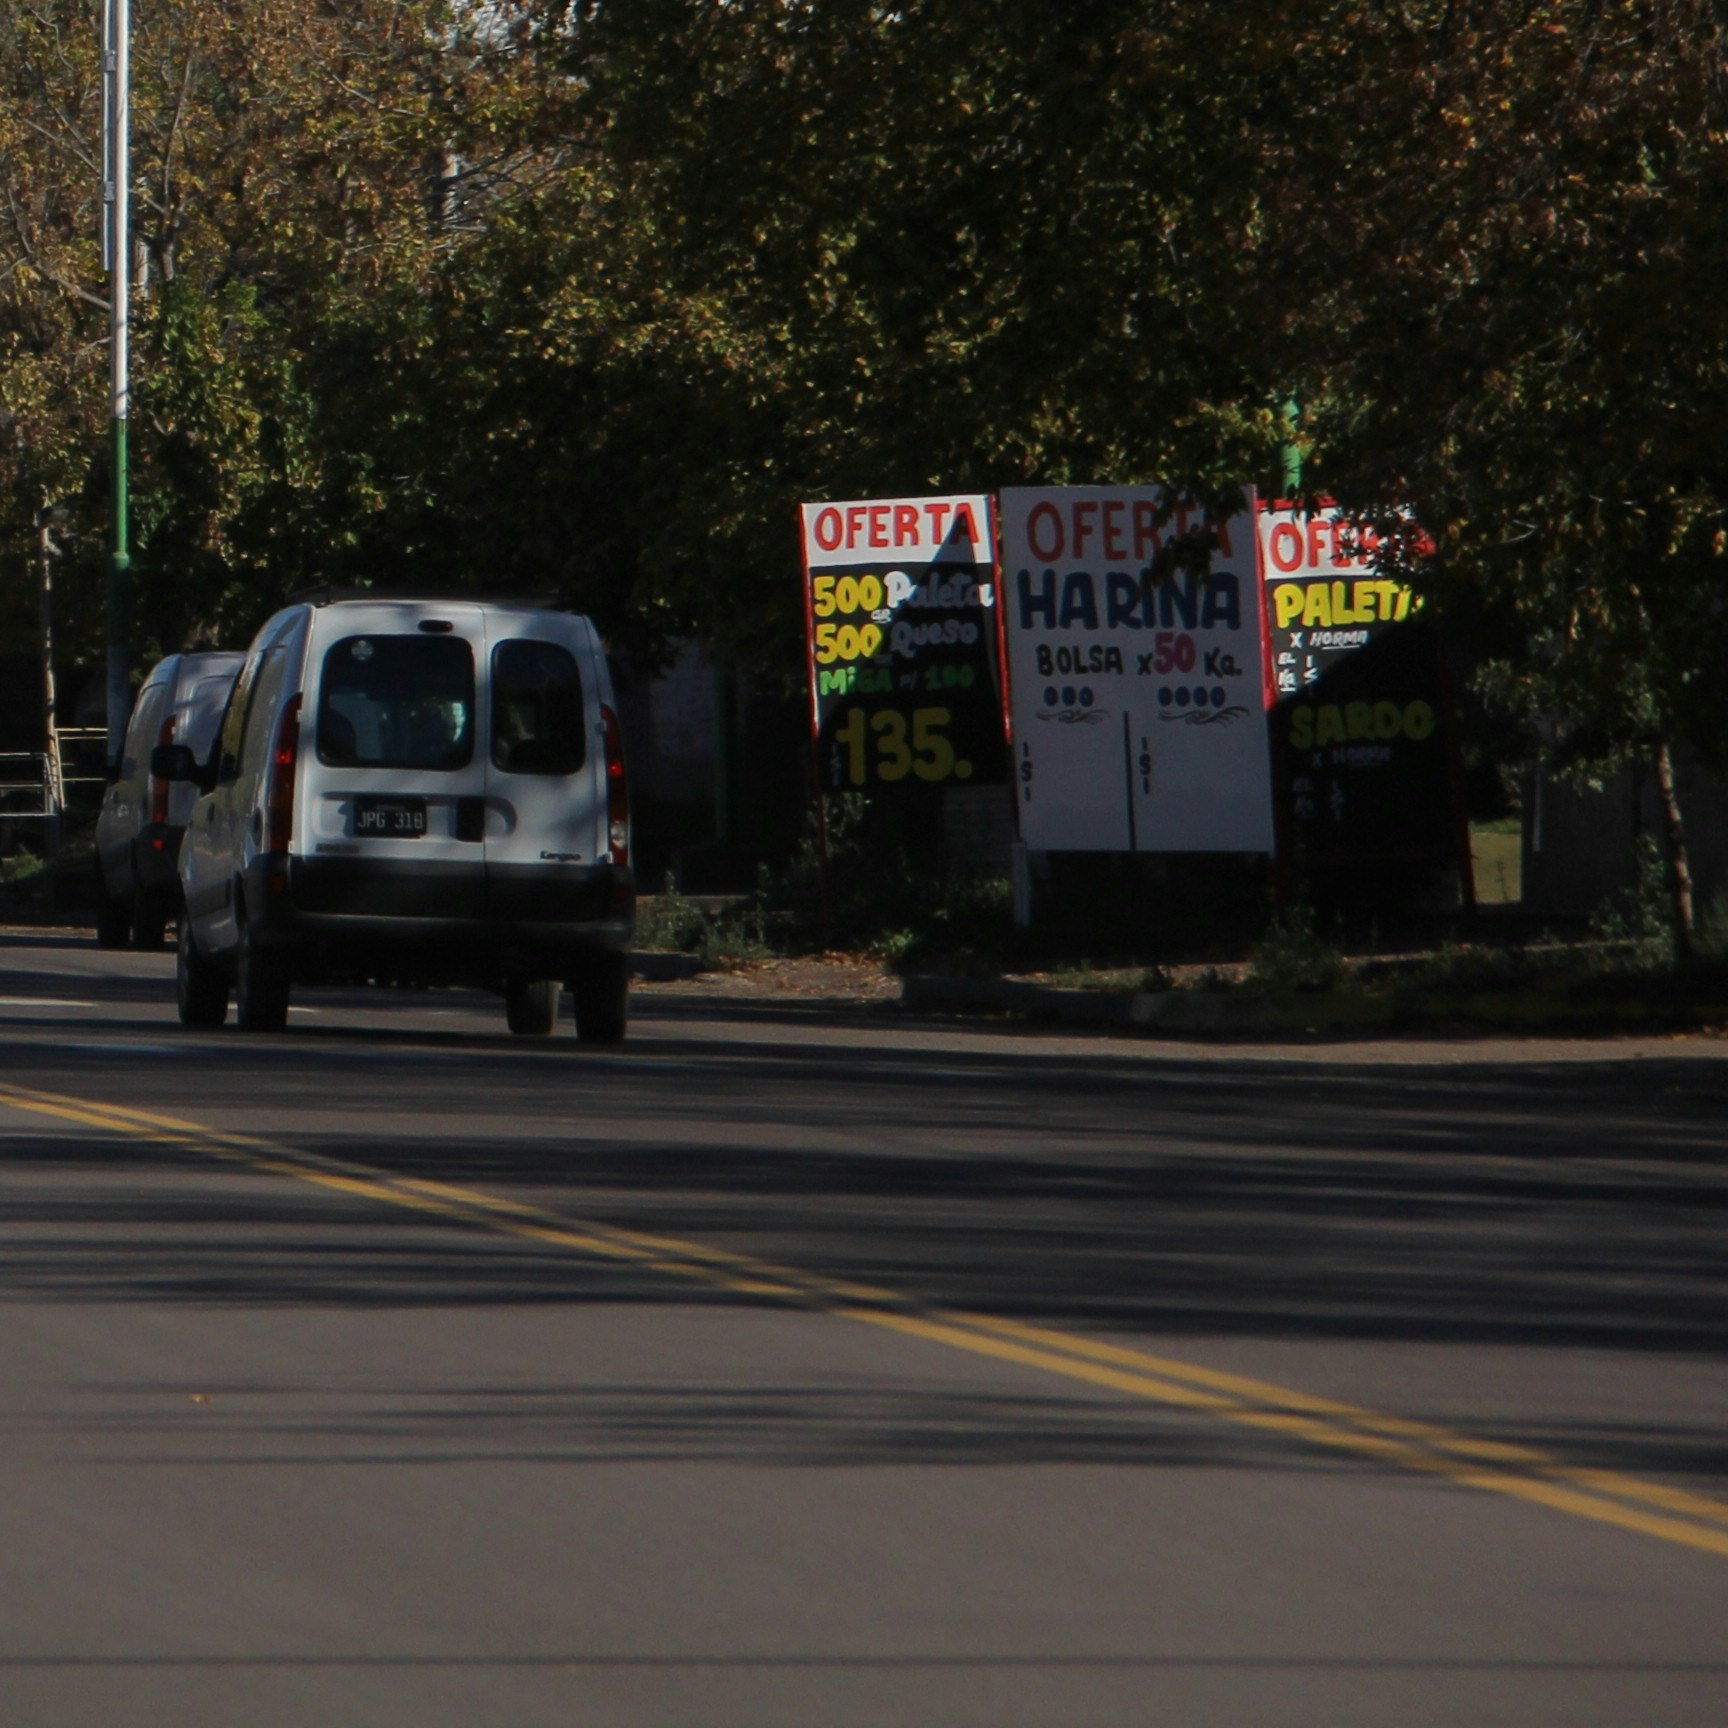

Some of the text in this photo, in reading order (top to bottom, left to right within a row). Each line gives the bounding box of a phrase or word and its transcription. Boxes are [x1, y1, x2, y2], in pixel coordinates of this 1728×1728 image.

[813, 502, 981, 552] OFERTA
[812, 574, 884, 618] 500
[884, 569, 995, 609] Paleta
[1017, 568, 1241, 630] HARINA
[814, 618, 981, 665] 500 Queso
[1035, 643, 1124, 676] BOLSA
[1309, 629, 1369, 649] HORMA
[1288, 699, 1437, 752] SARDO
[356, 810, 387, 830] JPG
